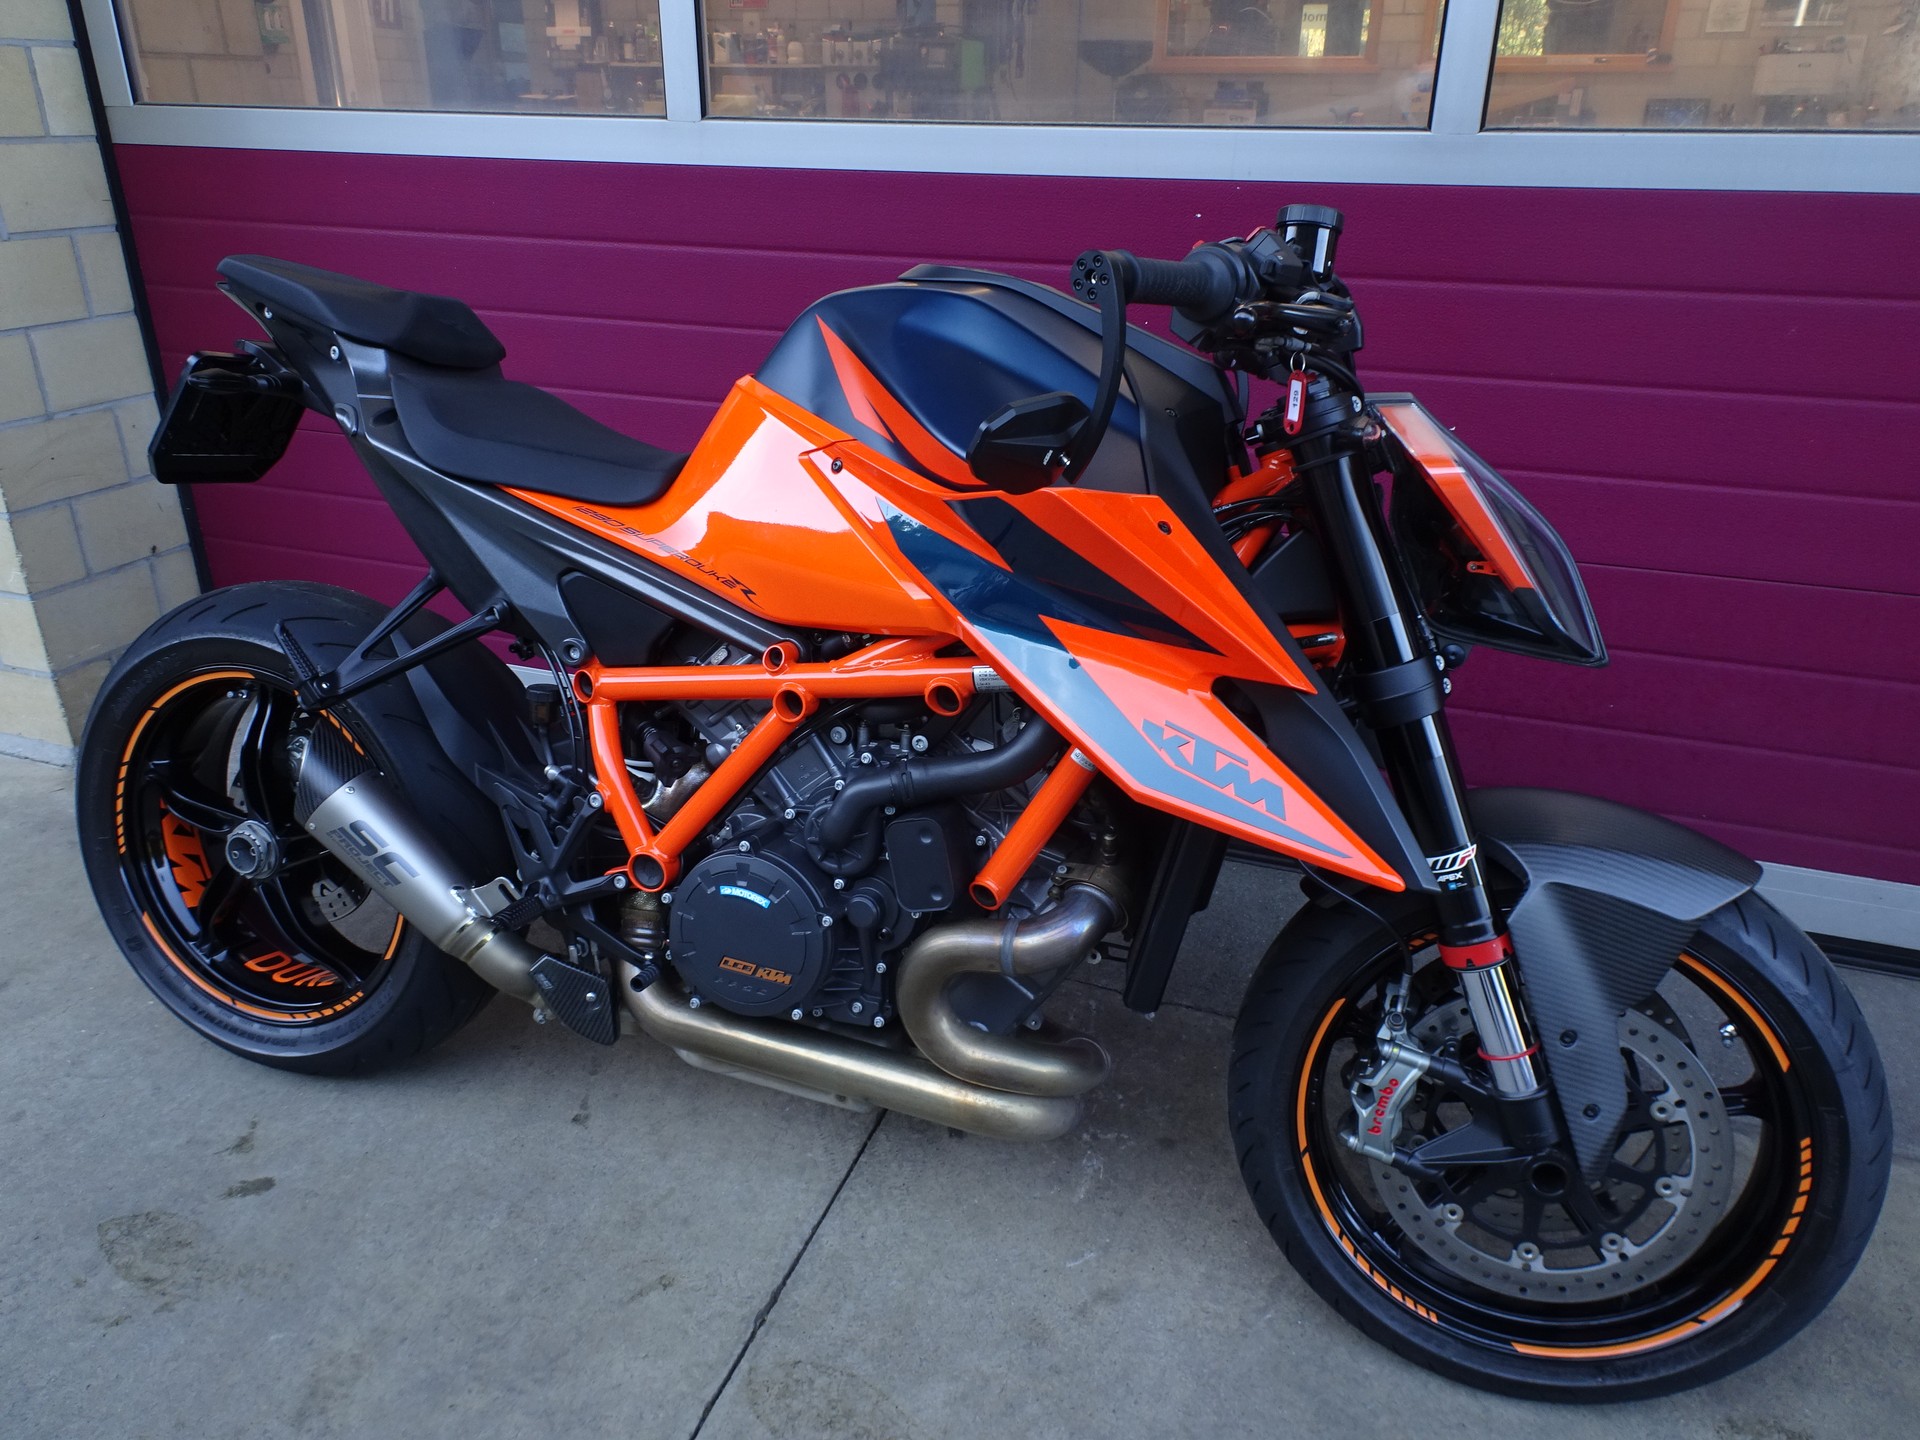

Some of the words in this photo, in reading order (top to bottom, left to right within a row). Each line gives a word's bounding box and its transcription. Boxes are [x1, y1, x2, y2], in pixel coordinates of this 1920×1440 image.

[1141, 718, 1287, 821] KTM
[326, 829, 397, 887] PROJECT
[337, 819, 421, 887] SC
[1437, 871, 1464, 883] APEX
[731, 887, 768, 907] MOTOREX
[755, 966, 793, 985] KTM
[1367, 1078, 1400, 1136] brembo
